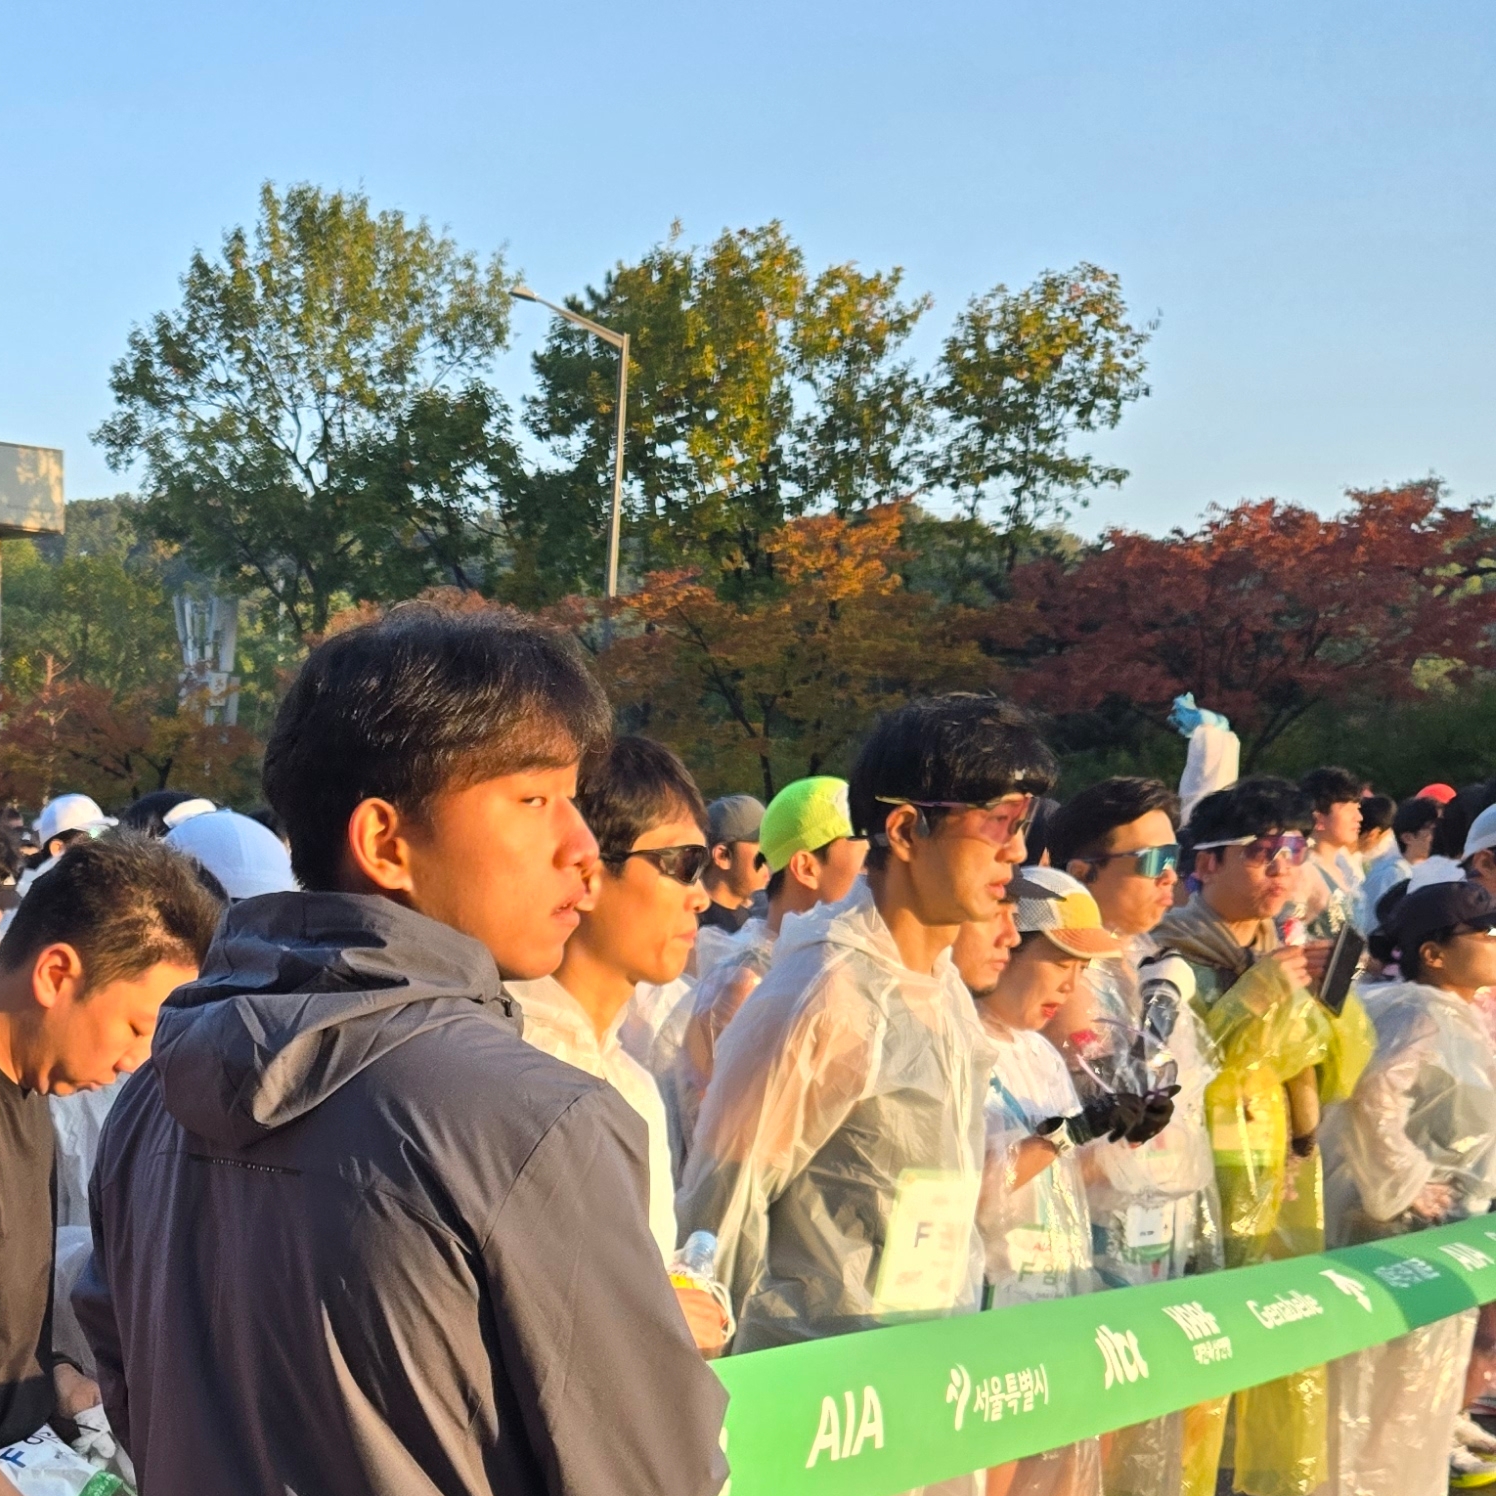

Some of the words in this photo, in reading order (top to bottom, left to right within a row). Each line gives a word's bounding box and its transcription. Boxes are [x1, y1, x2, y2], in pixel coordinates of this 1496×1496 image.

[914, 1222, 934, 1248] F
[972, 1363, 1049, 1422] 서울특별시
[805, 1385, 884, 1469] AIA
